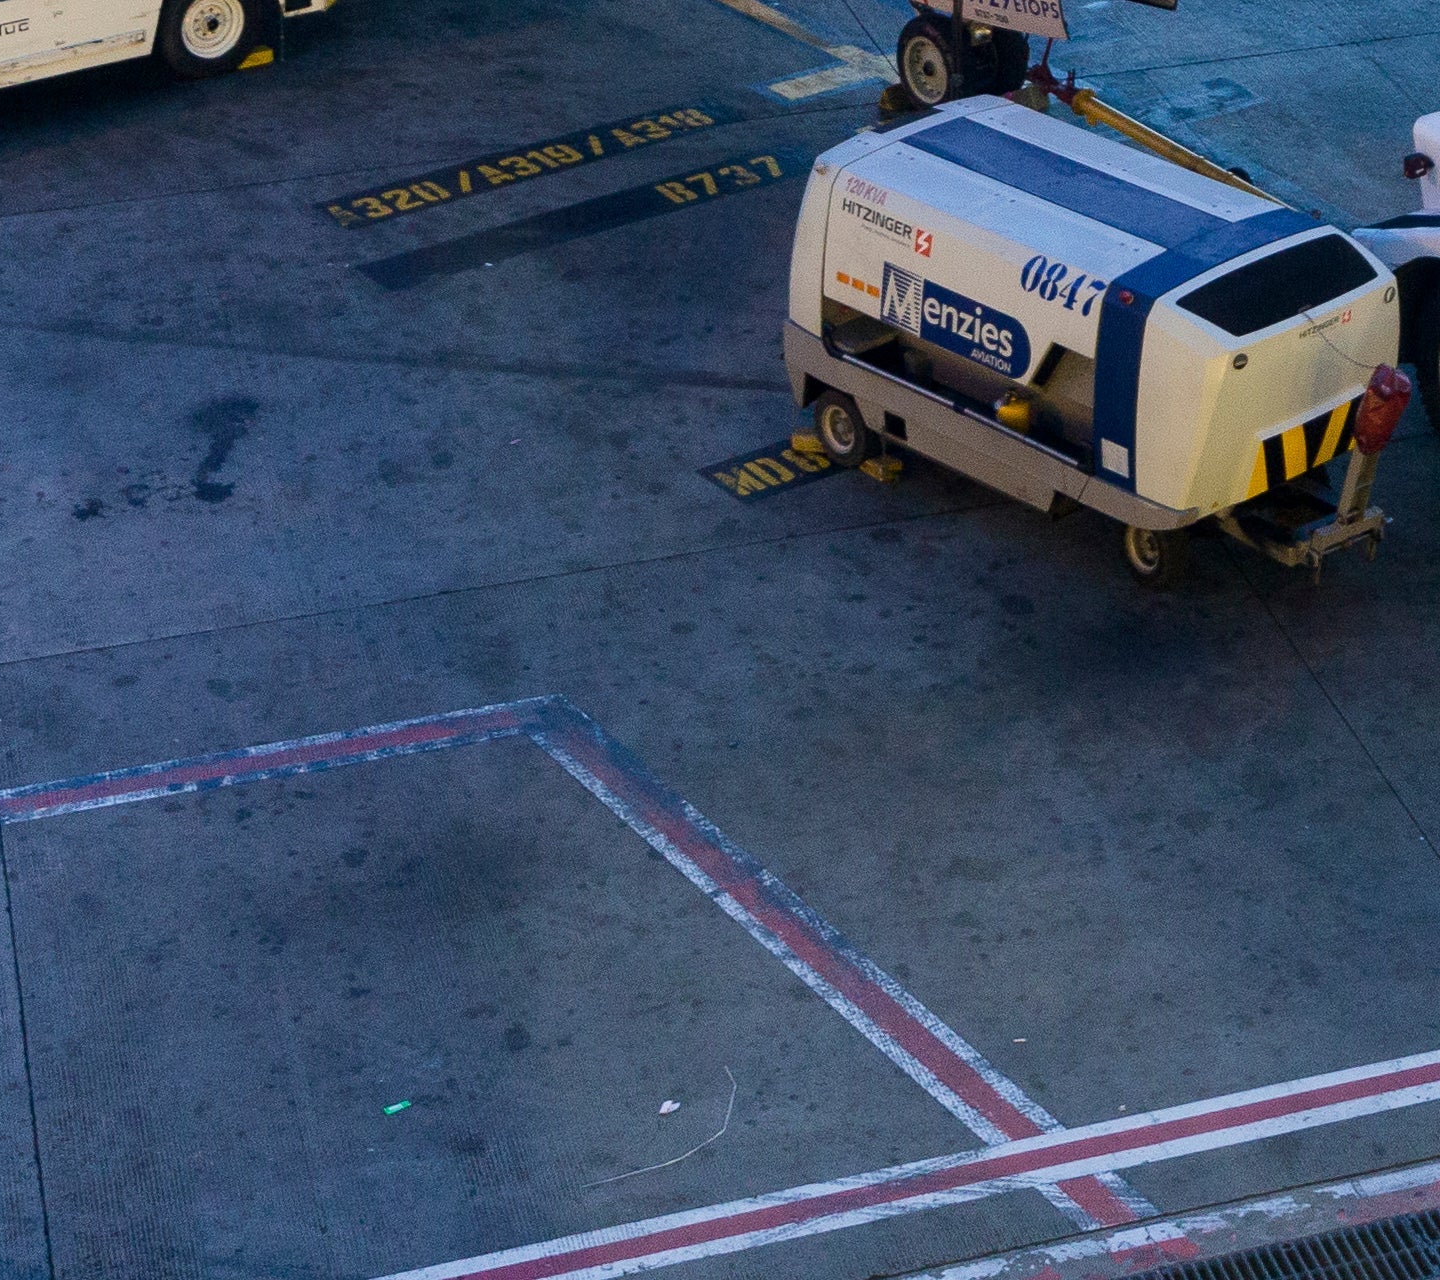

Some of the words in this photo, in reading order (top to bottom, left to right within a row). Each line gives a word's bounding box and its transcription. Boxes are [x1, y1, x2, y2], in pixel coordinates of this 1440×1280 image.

[477, 144, 584, 187] A319
[842, 198, 913, 240] HITZINGER
[1021, 254, 1108, 317] 0847
[881, 262, 1014, 358] Menzies
[970, 347, 1013, 373] AVIATION
